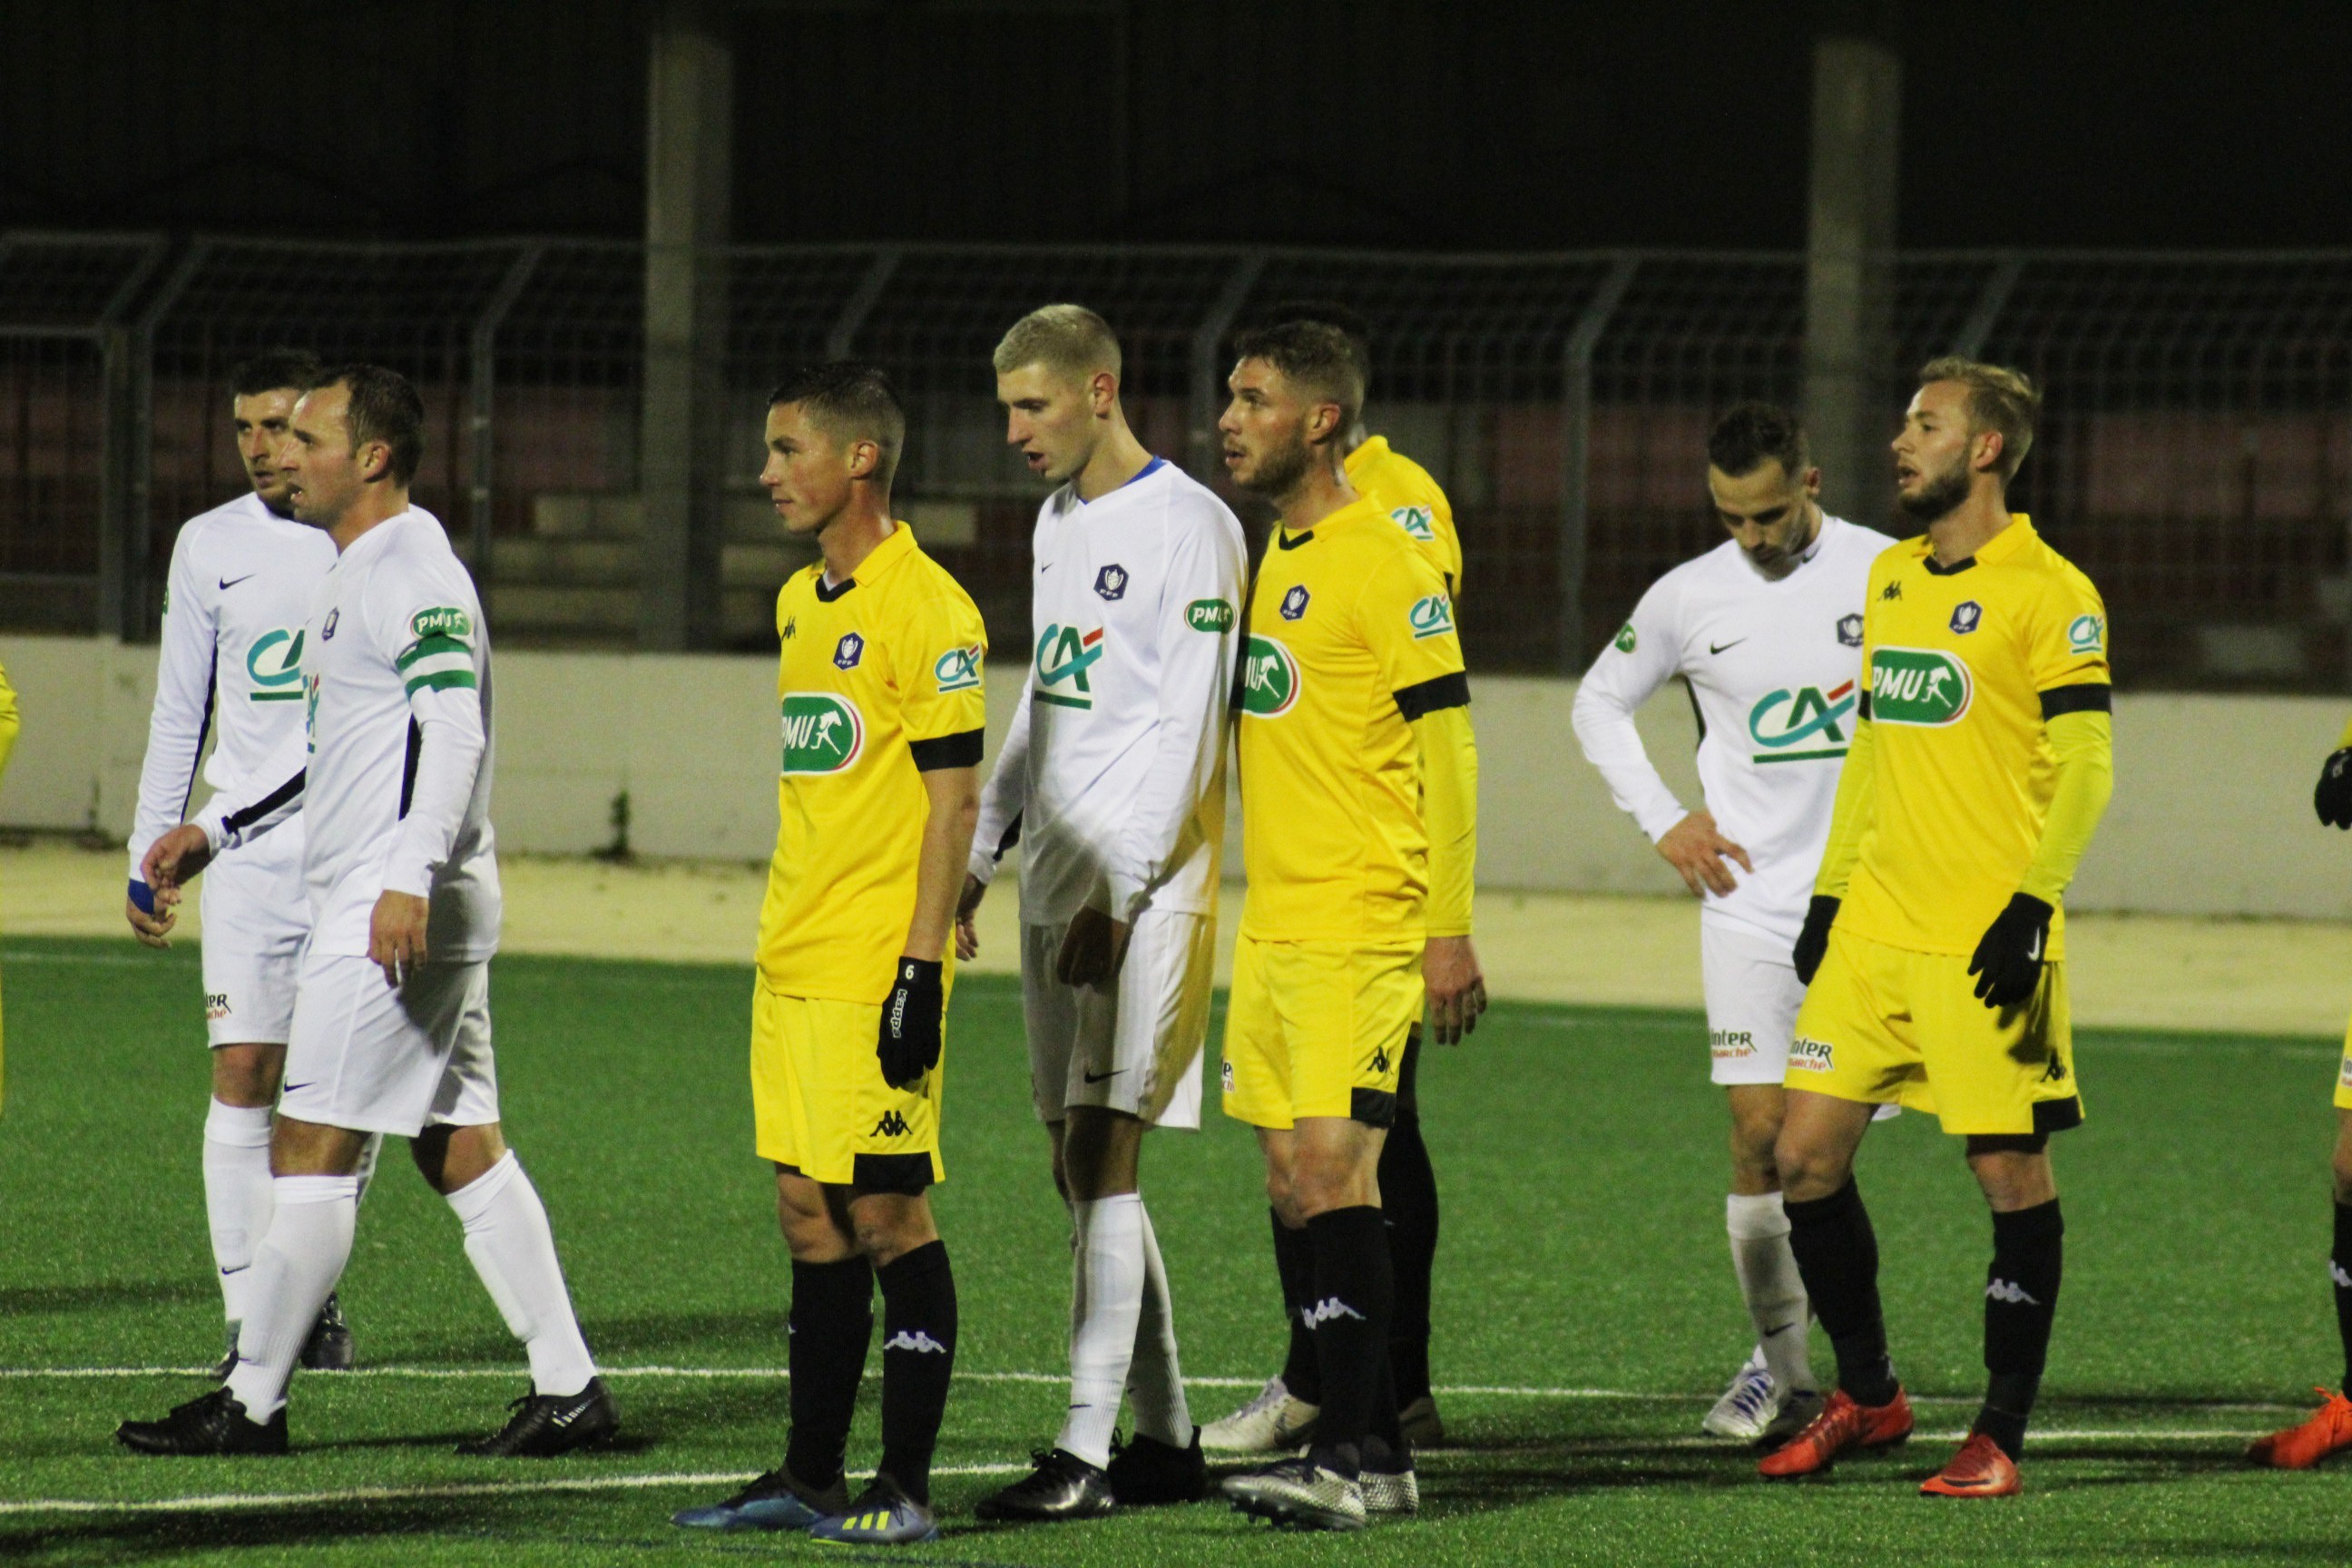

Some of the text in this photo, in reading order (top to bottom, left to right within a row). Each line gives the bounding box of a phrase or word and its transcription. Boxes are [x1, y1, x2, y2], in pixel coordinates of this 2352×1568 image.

[936, 644, 980, 681] CA
[1036, 623, 1102, 693] CA
[1749, 679, 1855, 748] CA
[905, 964, 915, 980] 6
[890, 988, 908, 1039] Kappa
